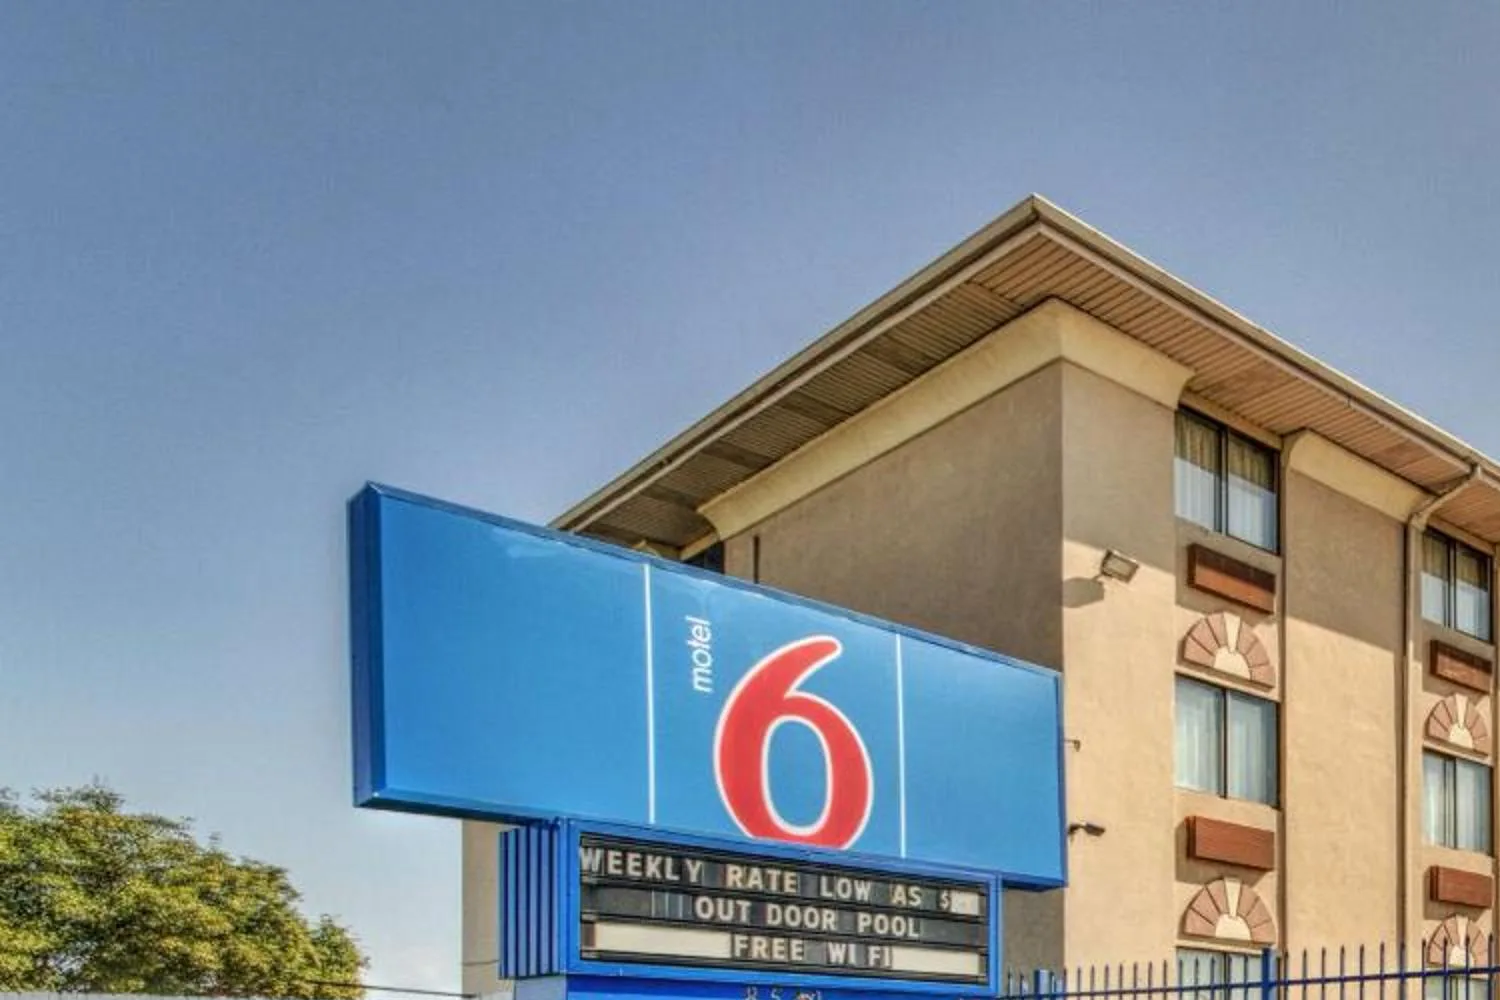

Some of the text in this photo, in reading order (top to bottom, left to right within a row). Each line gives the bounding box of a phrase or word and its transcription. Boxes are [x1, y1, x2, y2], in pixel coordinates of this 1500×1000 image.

[685, 614, 714, 693] motel
[713, 634, 875, 850] 6
[580, 848, 702, 883] WEEKLY
[726, 864, 798, 893] RATE
[820, 875, 871, 899] LOW
[892, 884, 922, 908] AS
[695, 895, 921, 939] OUT DOOR POOL
[734, 934, 892, 969] FREE WI FI
